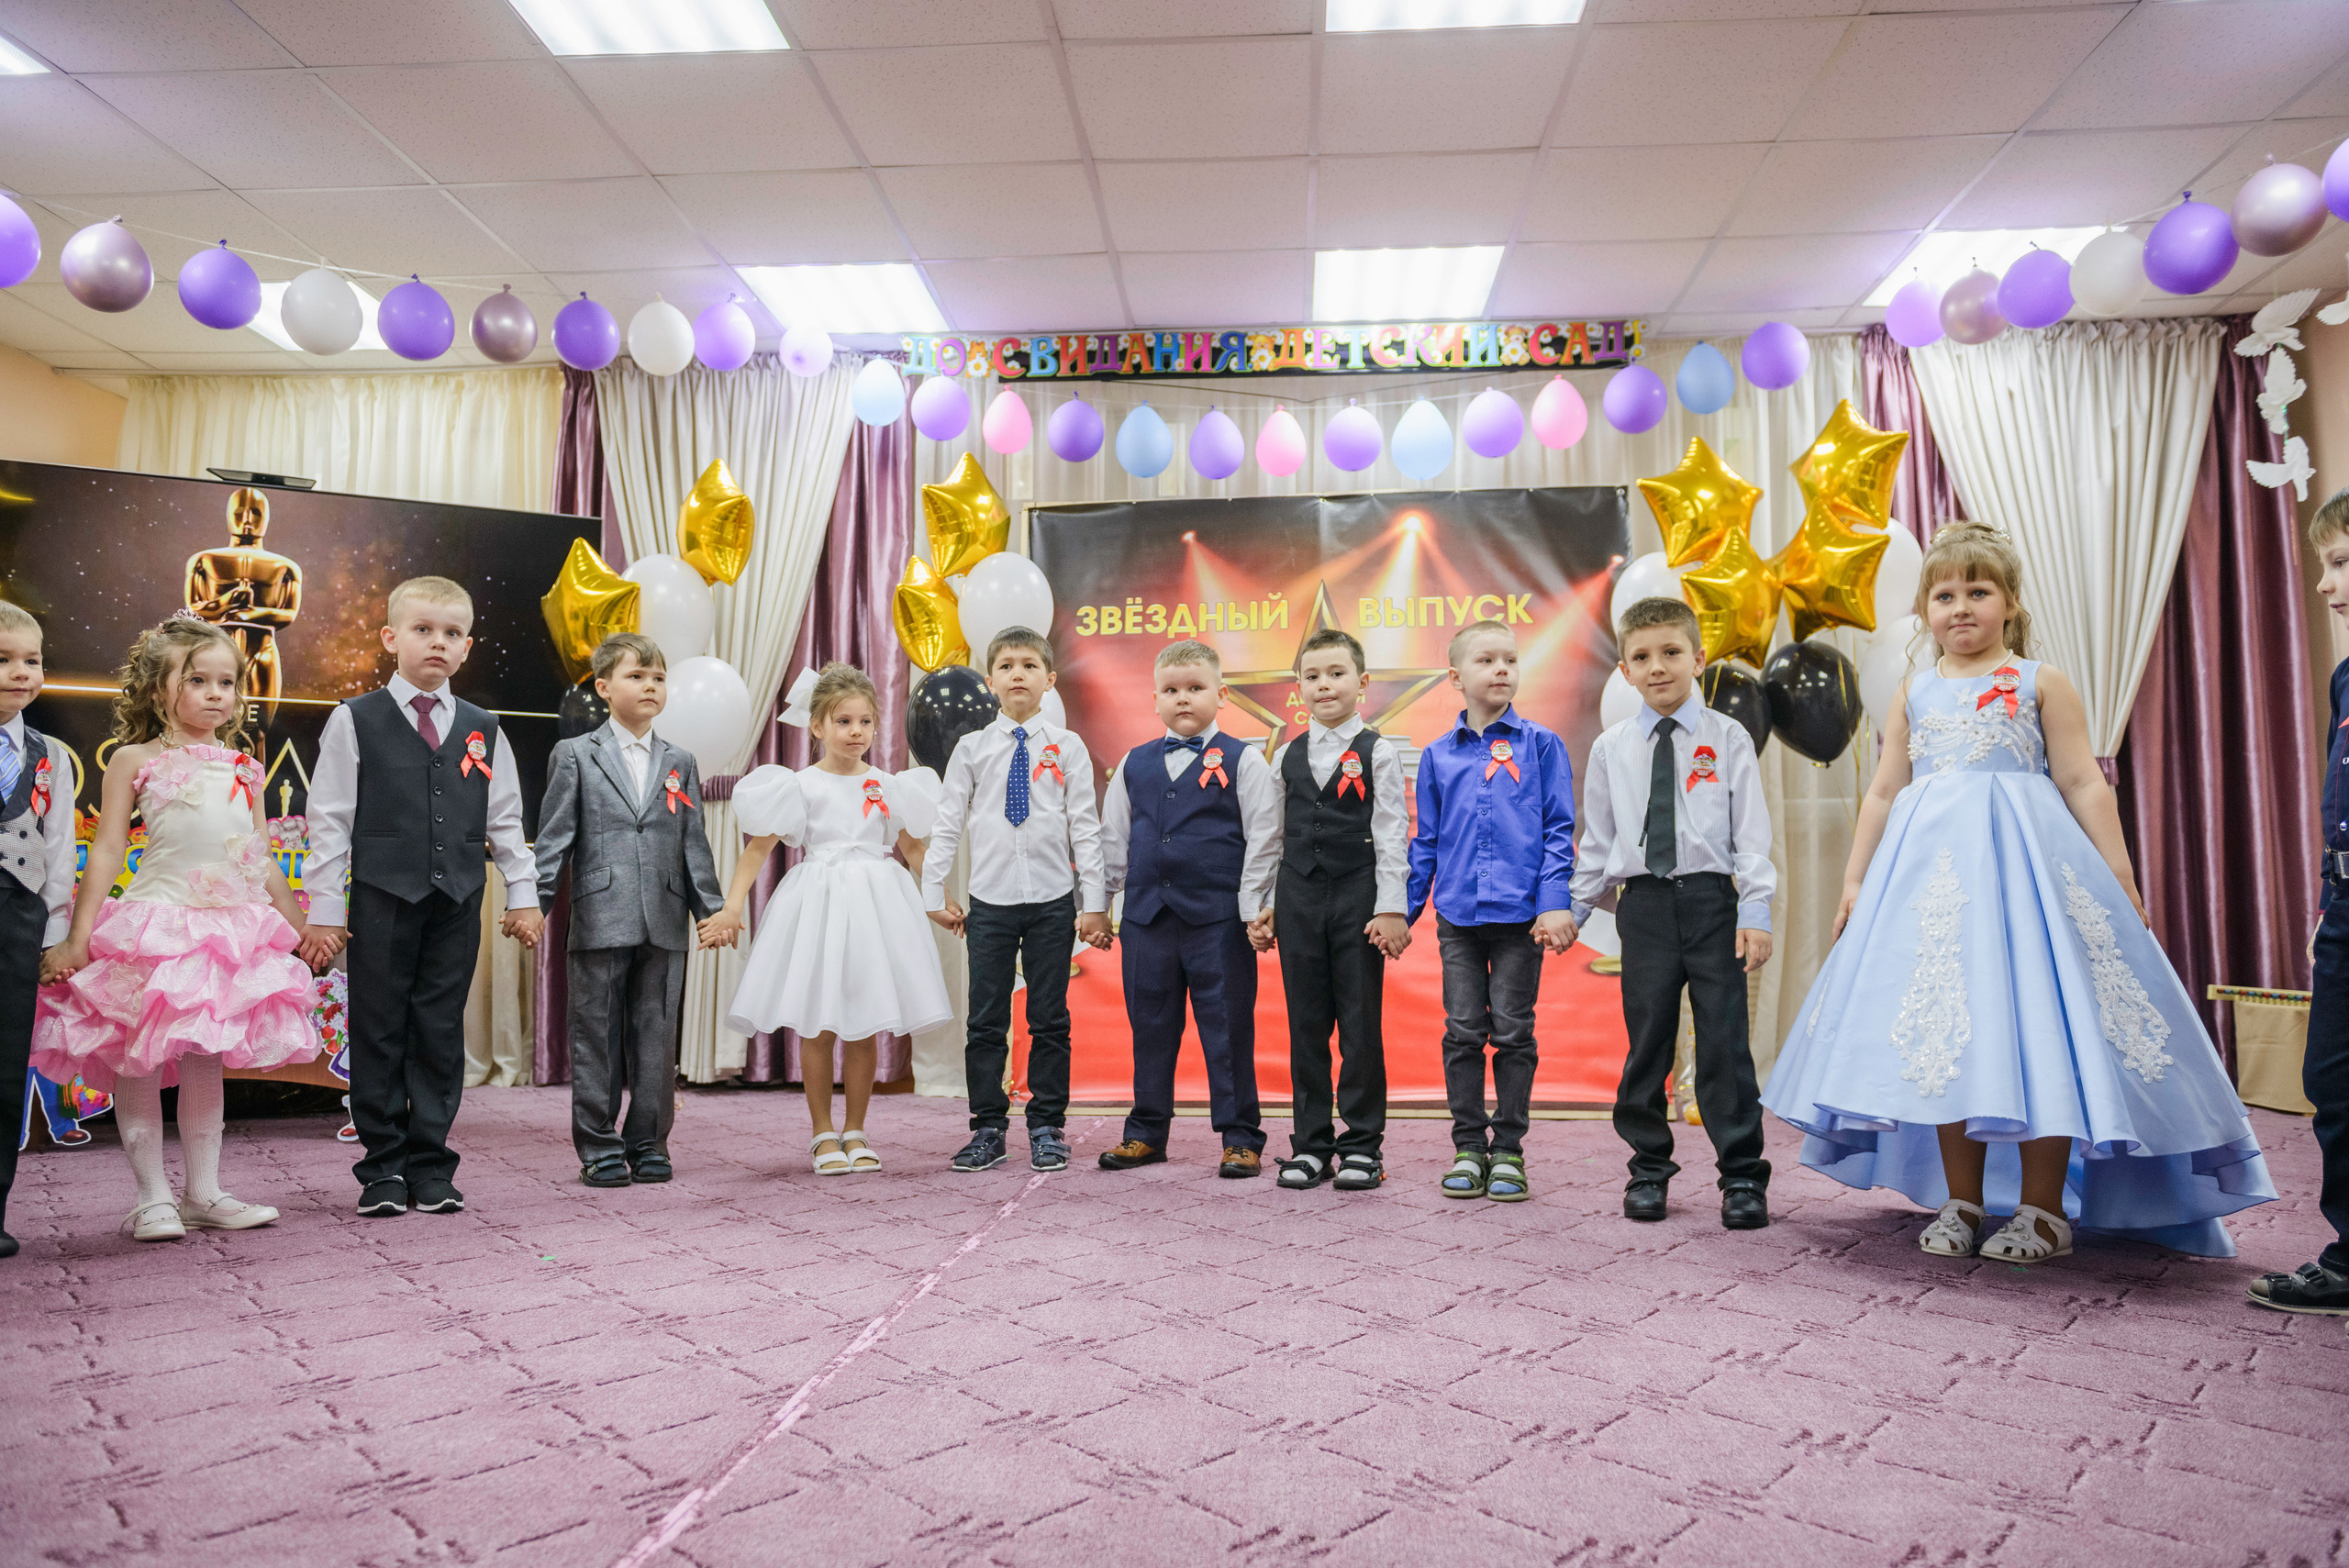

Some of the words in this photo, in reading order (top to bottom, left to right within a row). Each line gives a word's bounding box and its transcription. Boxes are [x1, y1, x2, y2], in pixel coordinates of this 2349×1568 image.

[902, 334, 966, 376] ДО
[993, 330, 1252, 378] СВИДАНИЯ
[1275, 324, 1503, 371] ДЕТСКИЙ
[1075, 591, 1288, 639] ЗВЁЗДНЫЙ
[1358, 593, 1535, 628] ВЫПУСК
